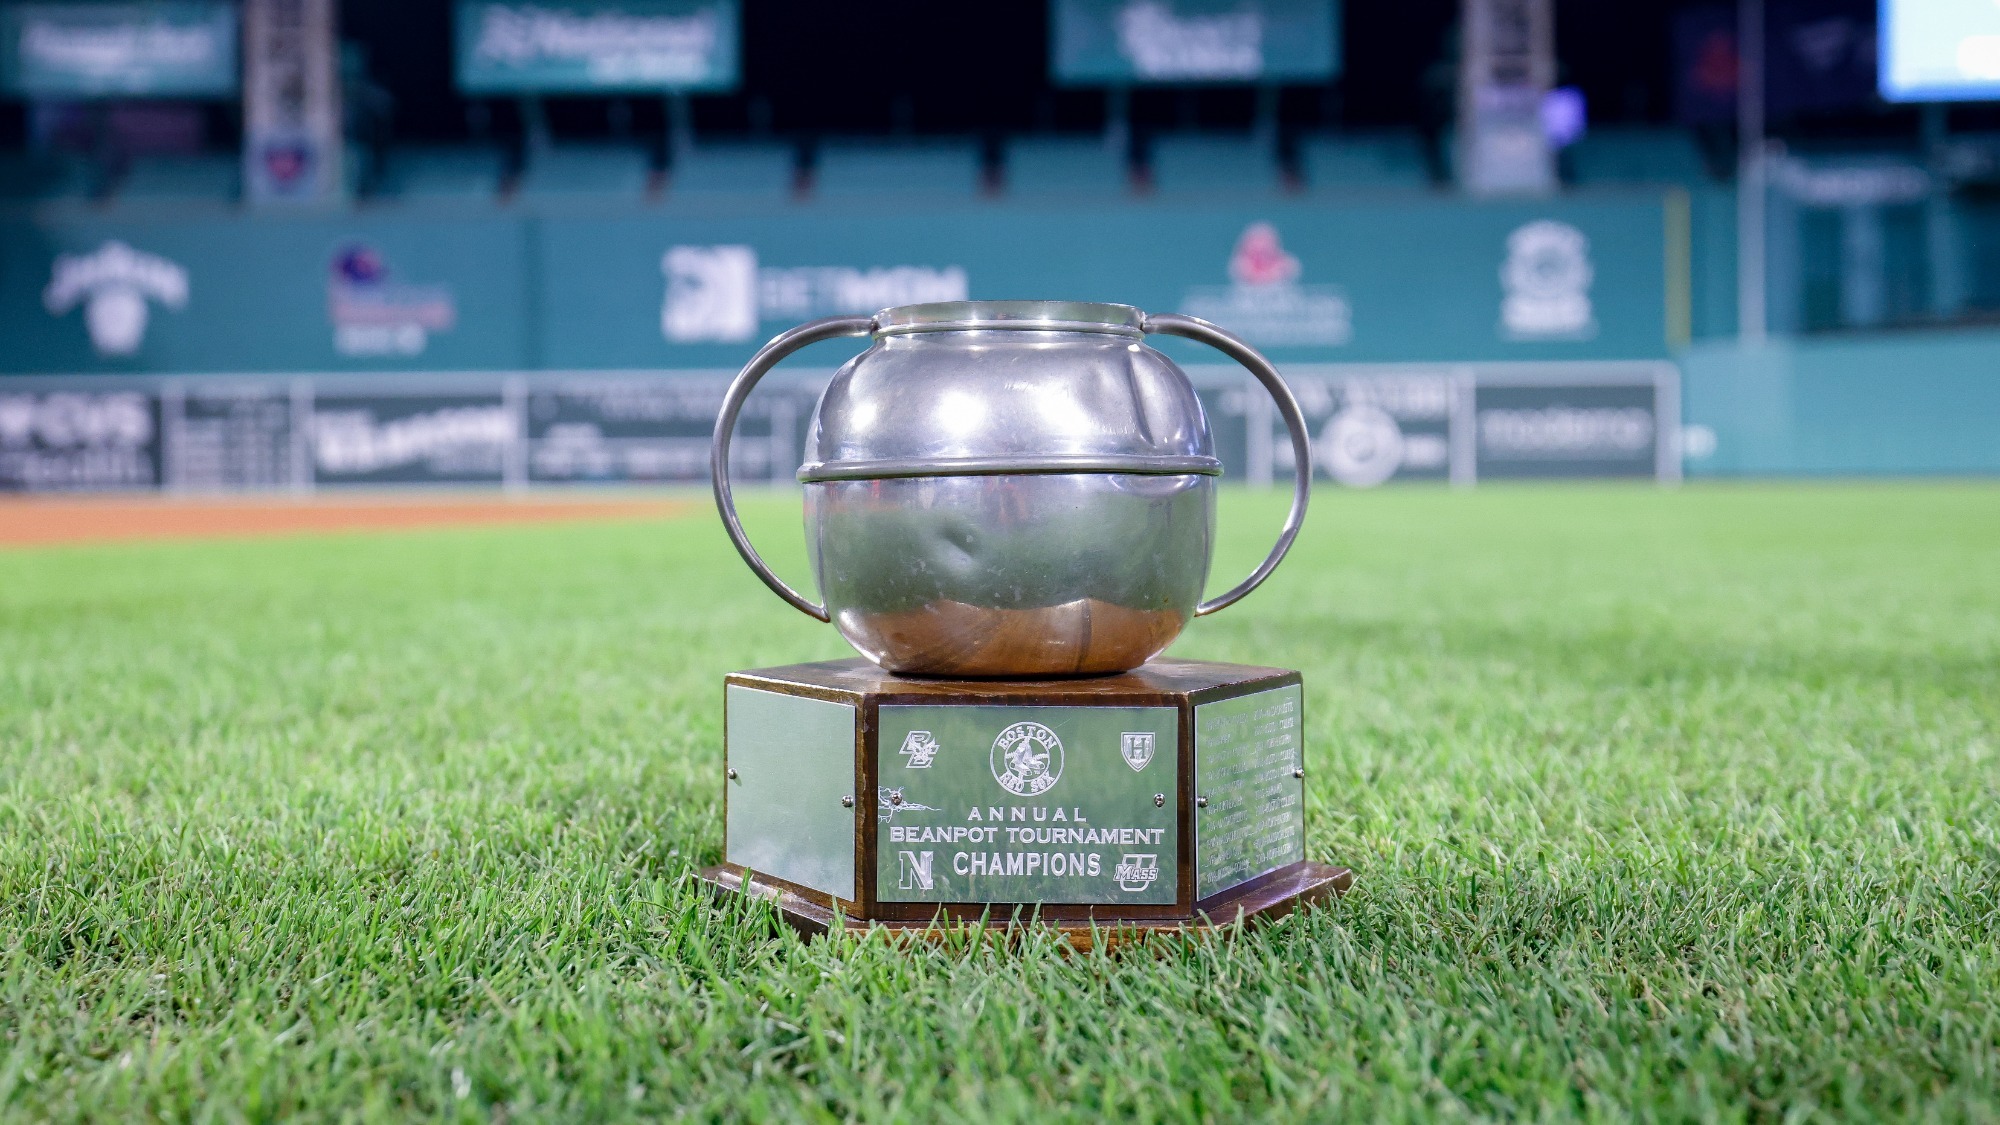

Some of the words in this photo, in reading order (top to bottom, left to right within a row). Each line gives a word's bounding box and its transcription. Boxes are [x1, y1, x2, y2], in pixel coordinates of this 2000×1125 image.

[998, 725, 1057, 750] BOSTON
[999, 770, 1025, 792] RED
[1031, 771, 1056, 792] SOX
[968, 807, 1087, 822] ANNUAL
[890, 826, 998, 843] BEANPOT
[1006, 827, 1165, 845] TOURNAMENT
[899, 850, 934, 890] N
[953, 852, 1102, 877] CHAMPIONS
